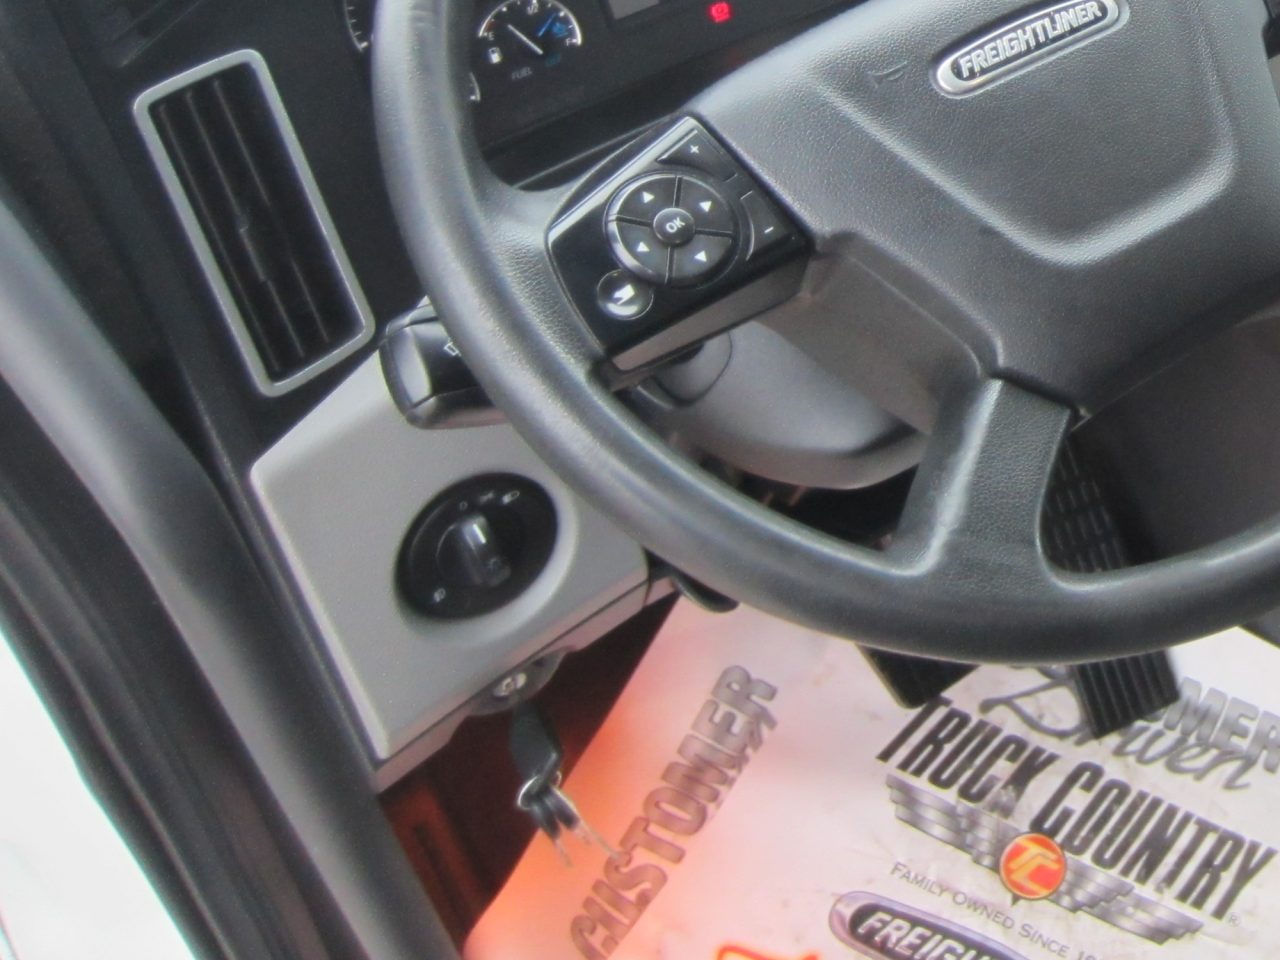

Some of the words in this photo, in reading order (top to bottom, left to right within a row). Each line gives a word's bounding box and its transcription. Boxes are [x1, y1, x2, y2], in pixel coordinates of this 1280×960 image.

[511, 67, 533, 81] FUEL
[958, 0, 1103, 78] FREIGHTLINER
[665, 216, 687, 233] OK
[877, 695, 1061, 819] TRUCK
[1028, 760, 1279, 922] COUNTRY
[891, 861, 949, 898] FAMILY
[952, 890, 1015, 930] OWNED
[1019, 922, 1071, 958] SINCE
